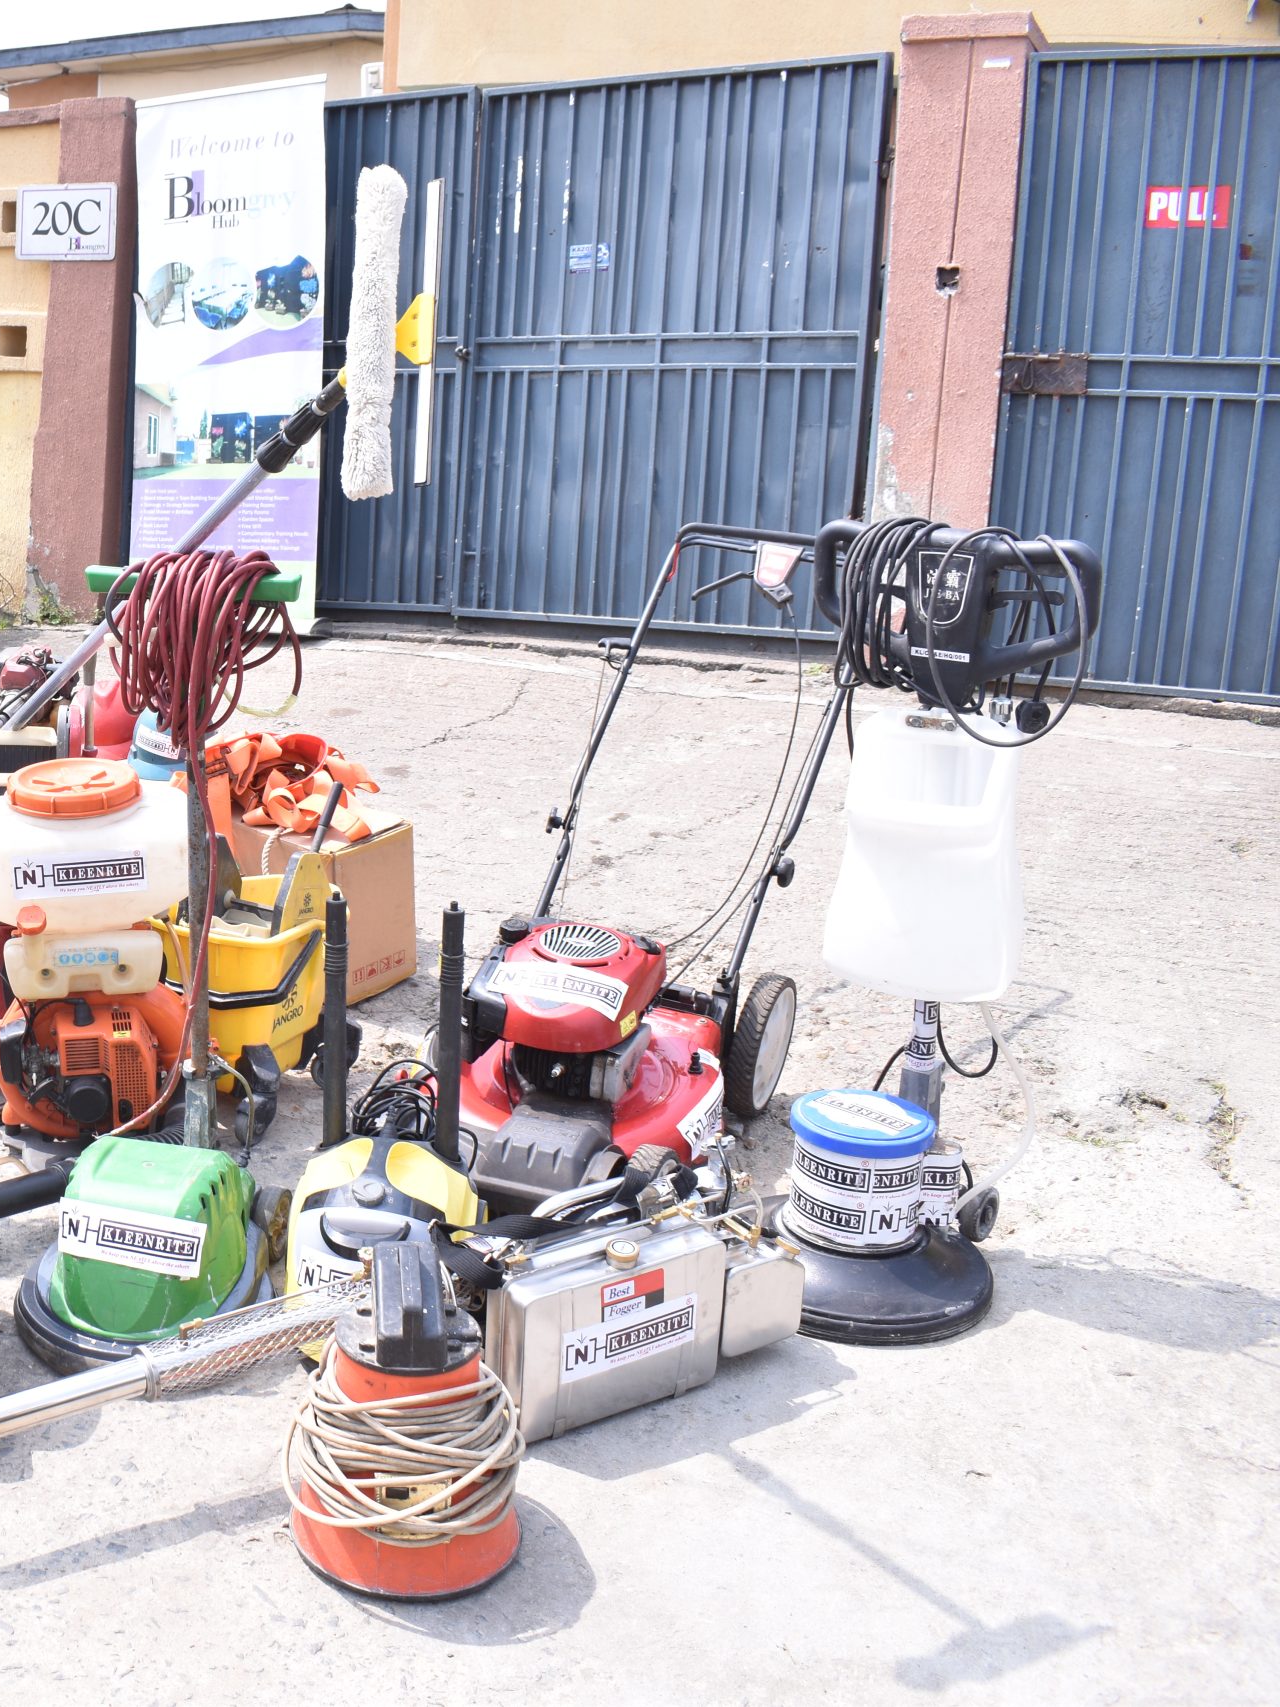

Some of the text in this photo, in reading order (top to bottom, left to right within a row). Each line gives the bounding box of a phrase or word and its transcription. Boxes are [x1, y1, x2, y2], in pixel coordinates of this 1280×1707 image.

[170, 130, 296, 159] Welcome to
[164, 170, 297, 219] Bloomgrey
[32, 199, 102, 236] 20C
[212, 214, 240, 229] Hub
[58, 863, 139, 881] KLEENRITE
[272, 1005, 304, 1034] JANGRO
[103, 1227, 193, 1255] KLEENRITE
[609, 1286, 631, 1300] Best
[608, 1301, 642, 1317] Fogger
[610, 1313, 689, 1351] KLEENRITE
